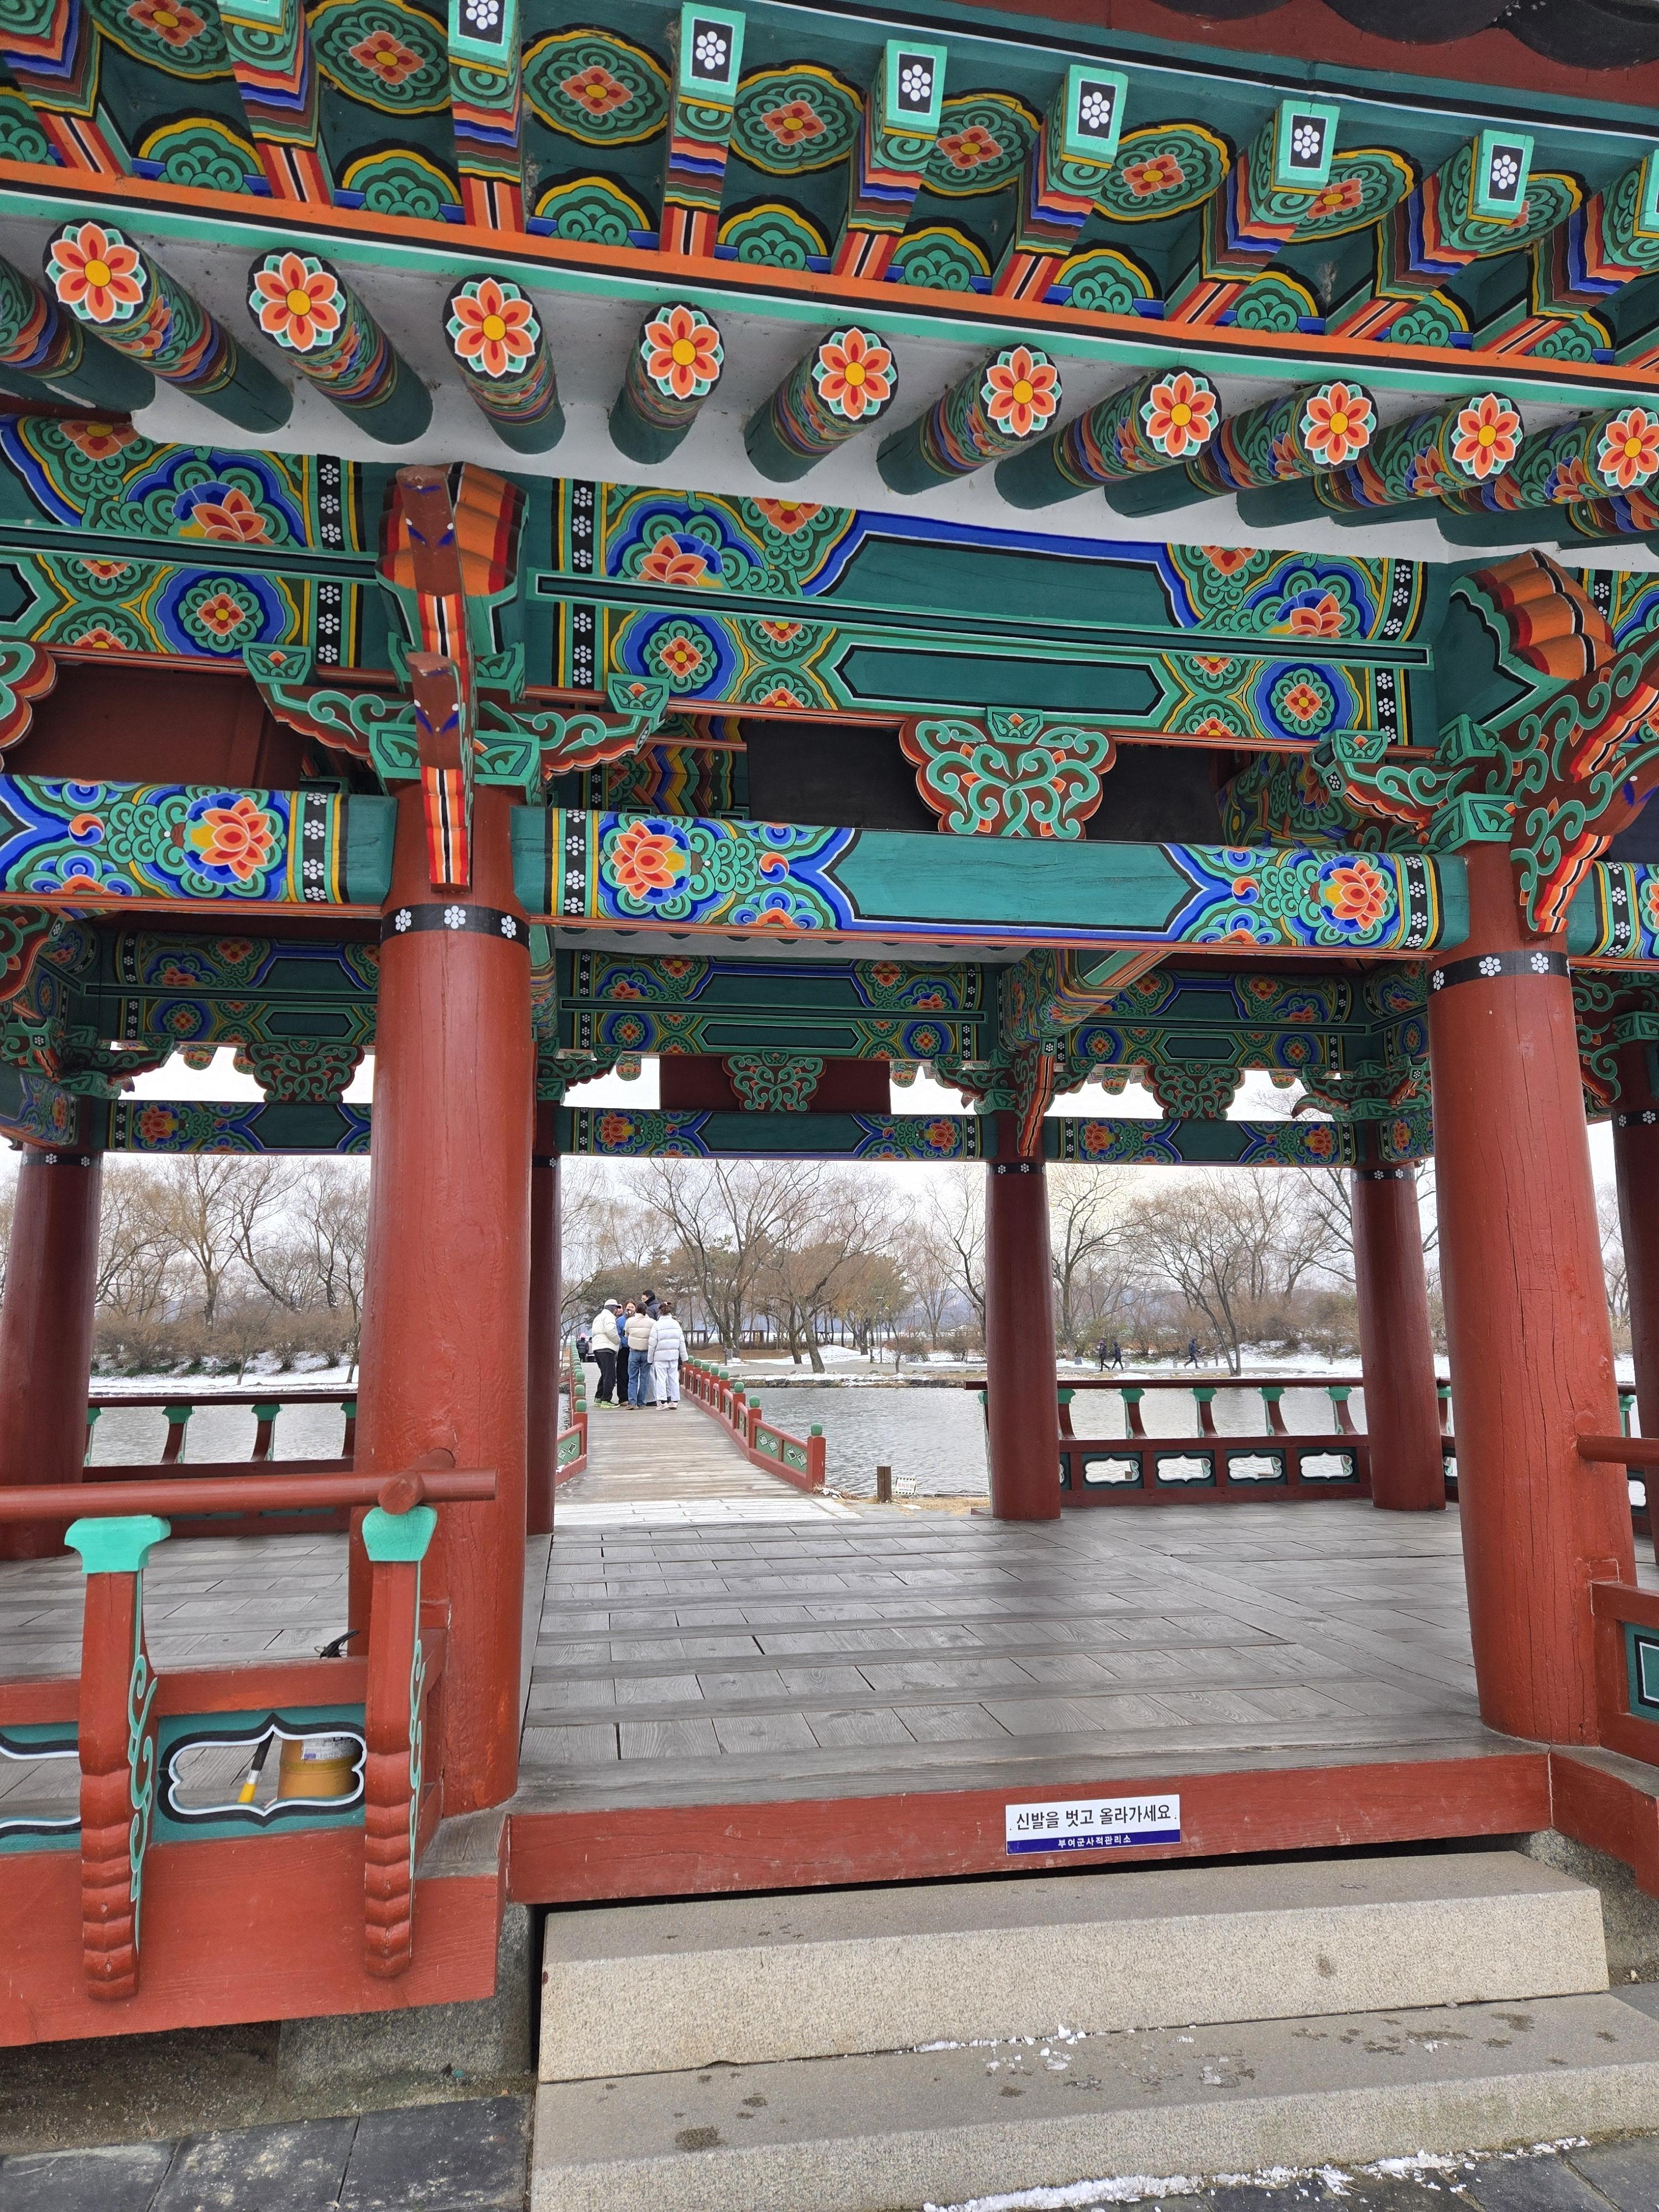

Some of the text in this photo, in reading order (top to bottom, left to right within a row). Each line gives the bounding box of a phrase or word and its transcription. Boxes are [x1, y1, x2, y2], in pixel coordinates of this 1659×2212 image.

[1016, 1804, 1171, 1830] 신발을 벗고 올라가세요
[1058, 1835, 1131, 1848] 부여군사적관리소
